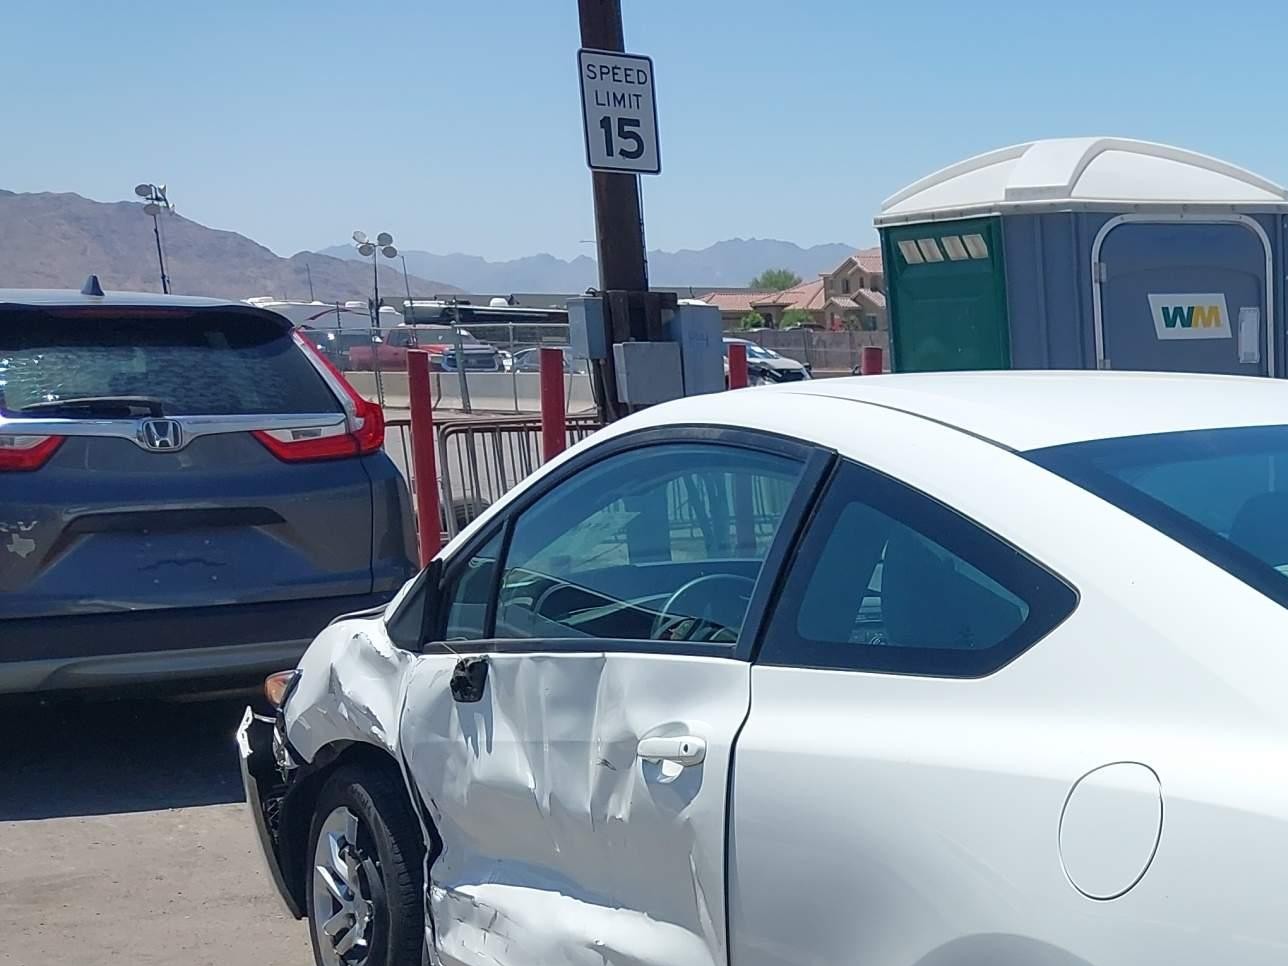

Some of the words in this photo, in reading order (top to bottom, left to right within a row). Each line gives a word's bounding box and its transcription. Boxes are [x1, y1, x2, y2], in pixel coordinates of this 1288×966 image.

[586, 64, 648, 85] SPEED
[594, 89, 643, 110] LIMIT
[599, 115, 645, 160] 15
[1161, 305, 1223, 329] WM
